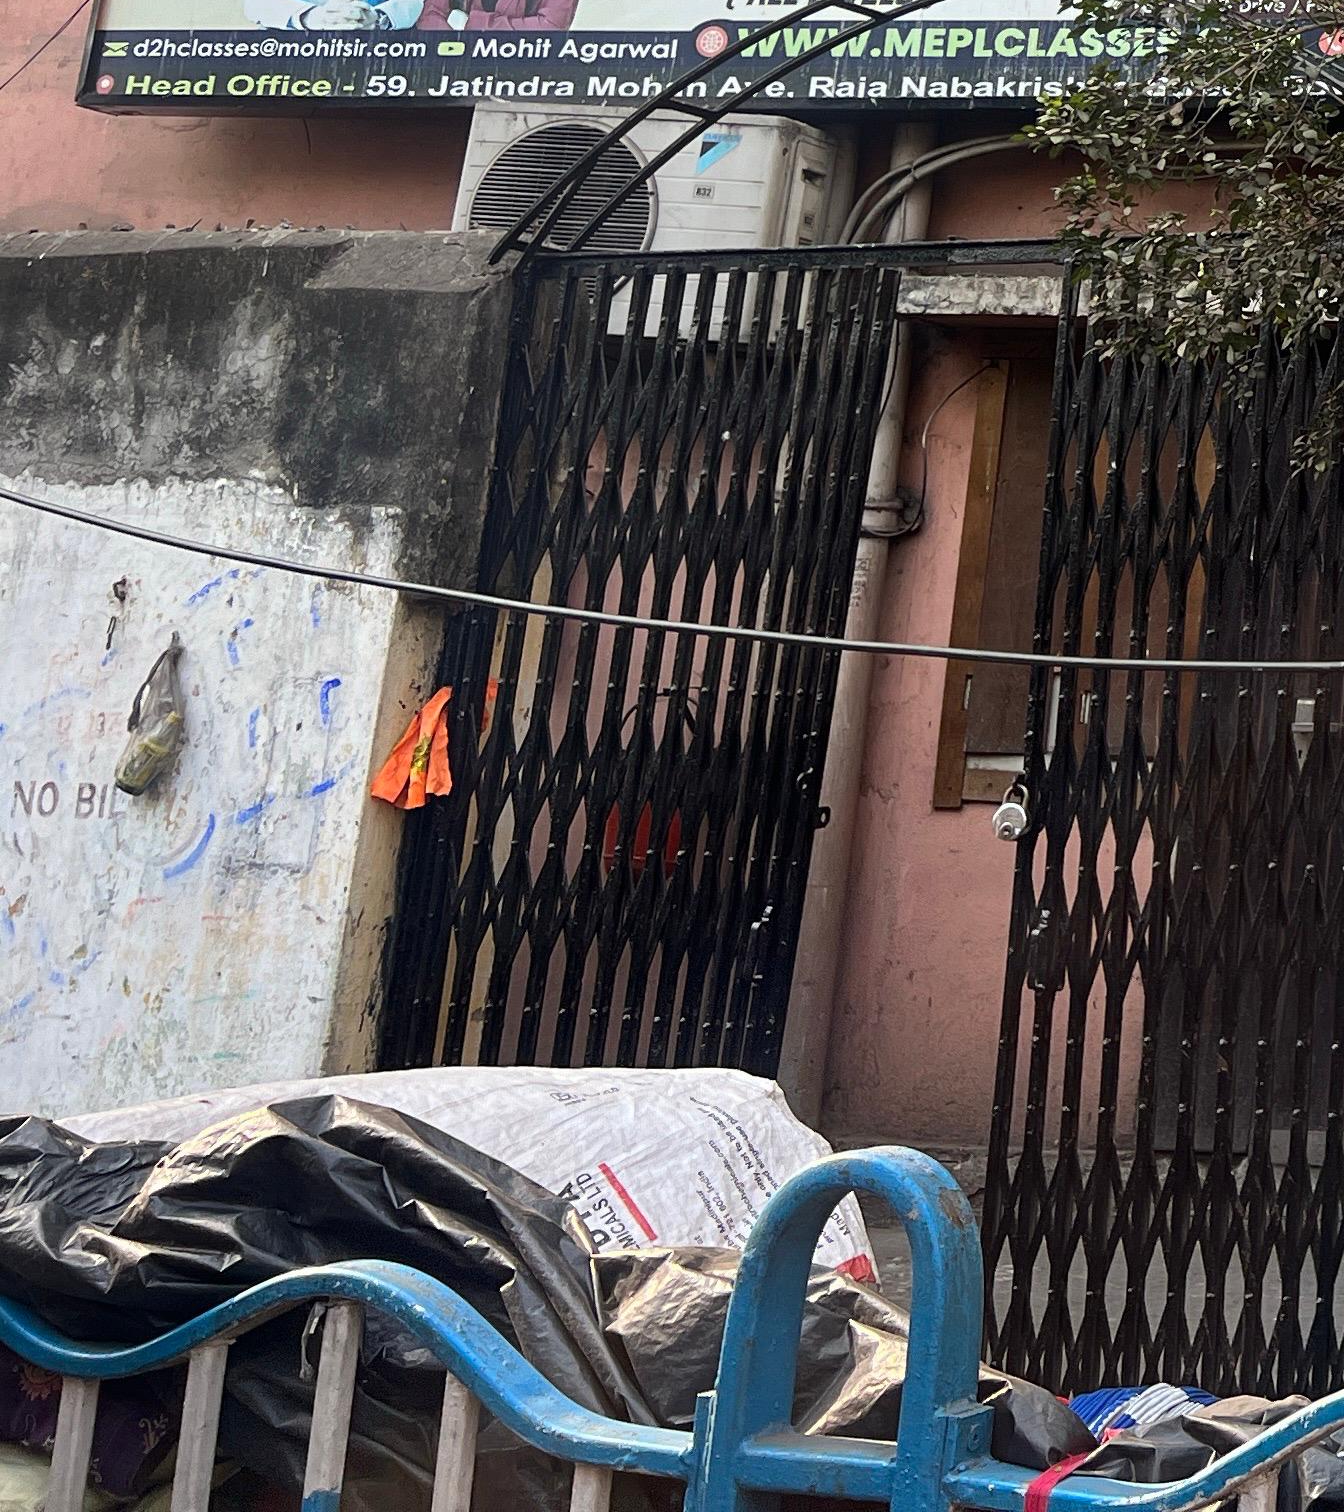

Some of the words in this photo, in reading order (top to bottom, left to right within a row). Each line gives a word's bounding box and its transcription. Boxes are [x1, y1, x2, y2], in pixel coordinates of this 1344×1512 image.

[132, 36, 428, 59] d2hclasses@mohitsir.com
[472, 35, 553, 59] Mohit
[557, 36, 678, 63] Agarwal
[124, 74, 220, 97] Head
[225, 73, 333, 97] Office
[428, 74, 576, 98] Jatindra
[10, 780, 60, 819] NO
[576, 1172, 602, 1200] LTD
